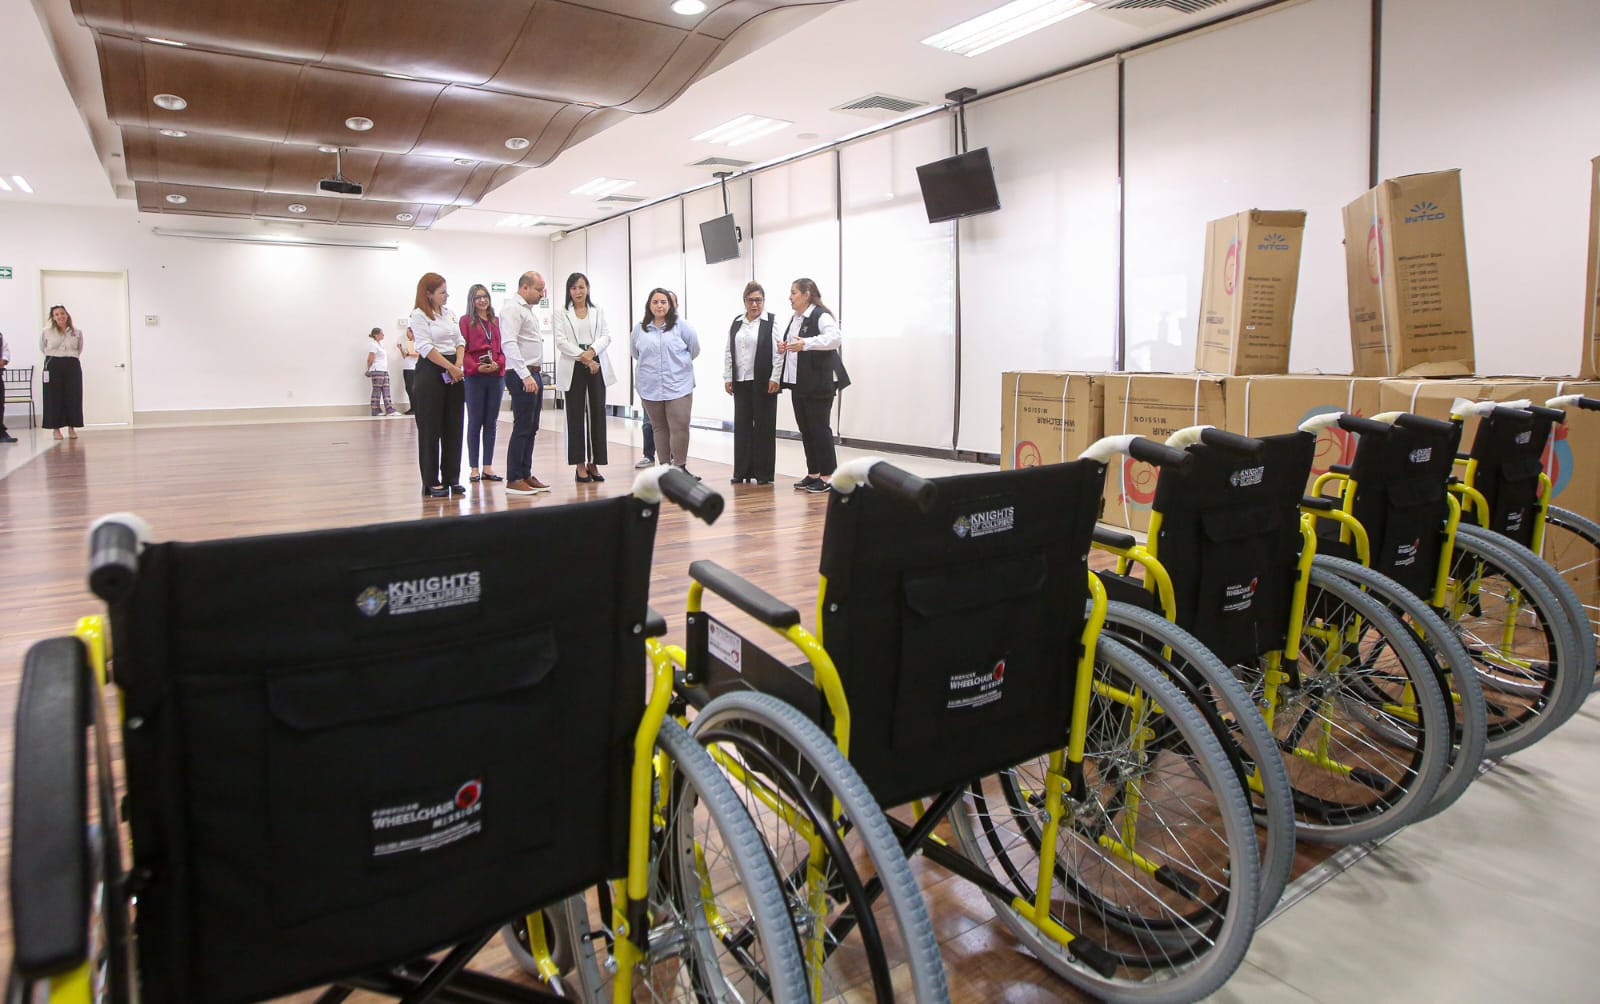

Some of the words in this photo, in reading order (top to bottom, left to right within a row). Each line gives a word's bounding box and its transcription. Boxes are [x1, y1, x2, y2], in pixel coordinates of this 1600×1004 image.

[1133, 416, 1167, 424] MISSION
[970, 506, 1014, 524] KNIGHTS
[388, 571, 480, 597] KNIGHTS
[372, 801, 455, 830] WHEELCHAIR
